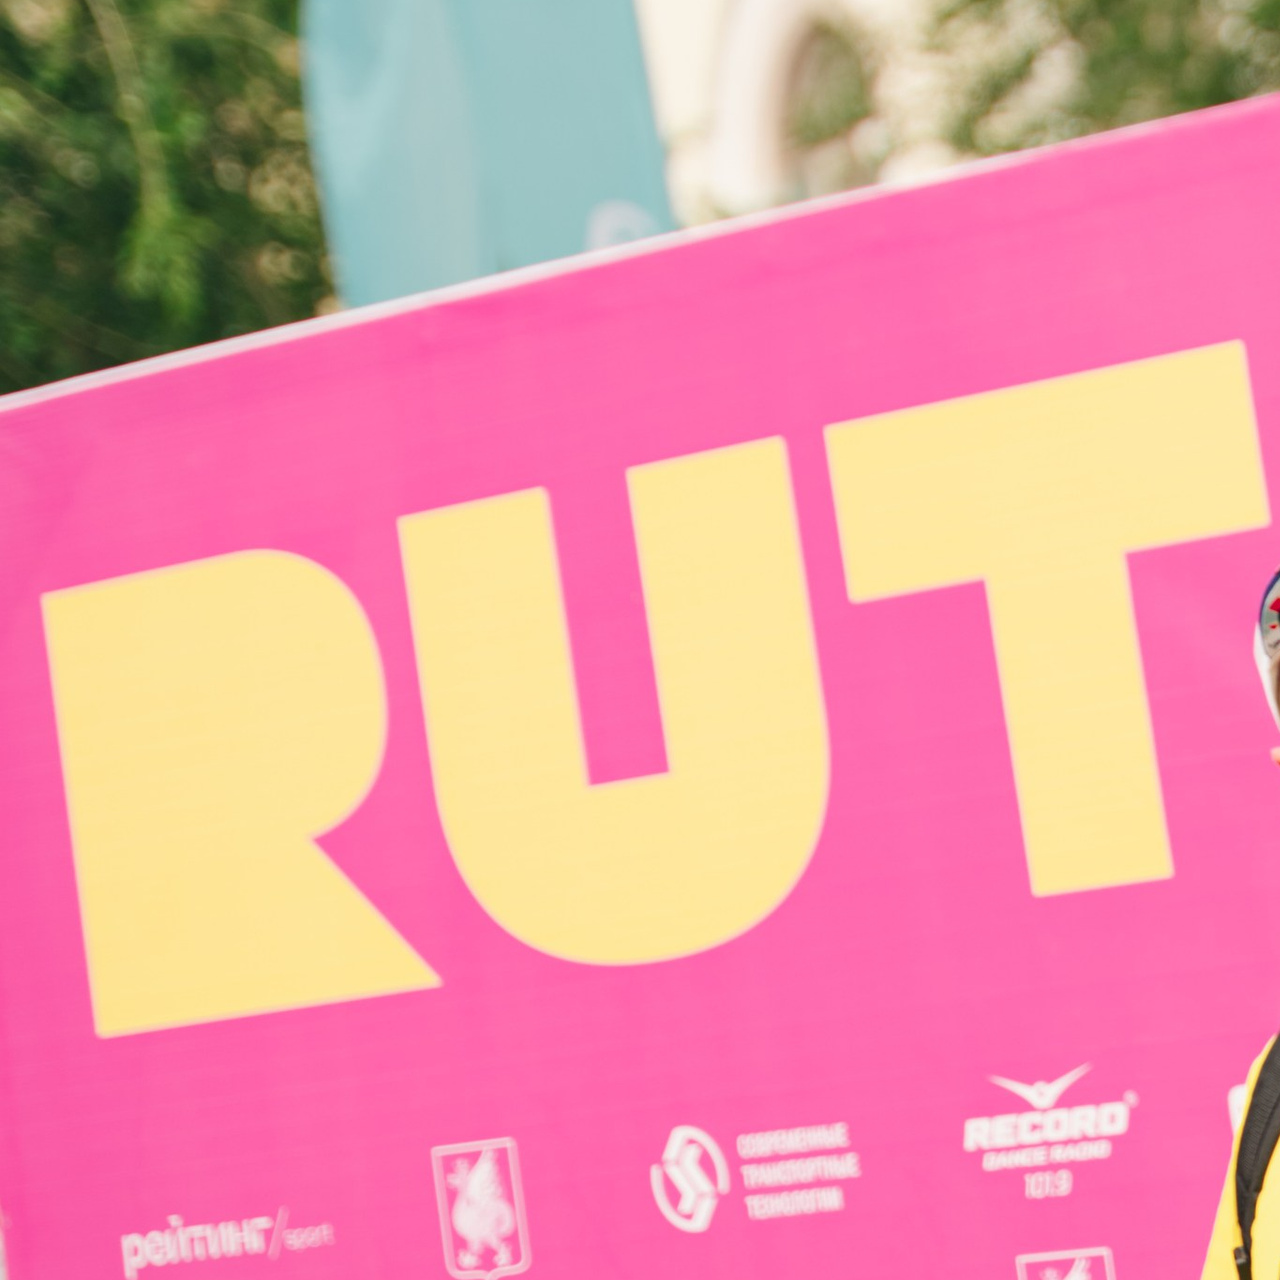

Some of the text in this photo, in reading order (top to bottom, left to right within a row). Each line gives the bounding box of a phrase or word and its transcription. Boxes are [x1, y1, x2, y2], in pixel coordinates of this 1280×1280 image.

[965, 1101, 1132, 1152] RECORD
[983, 1140, 1112, 1172] DANCE RADIO
